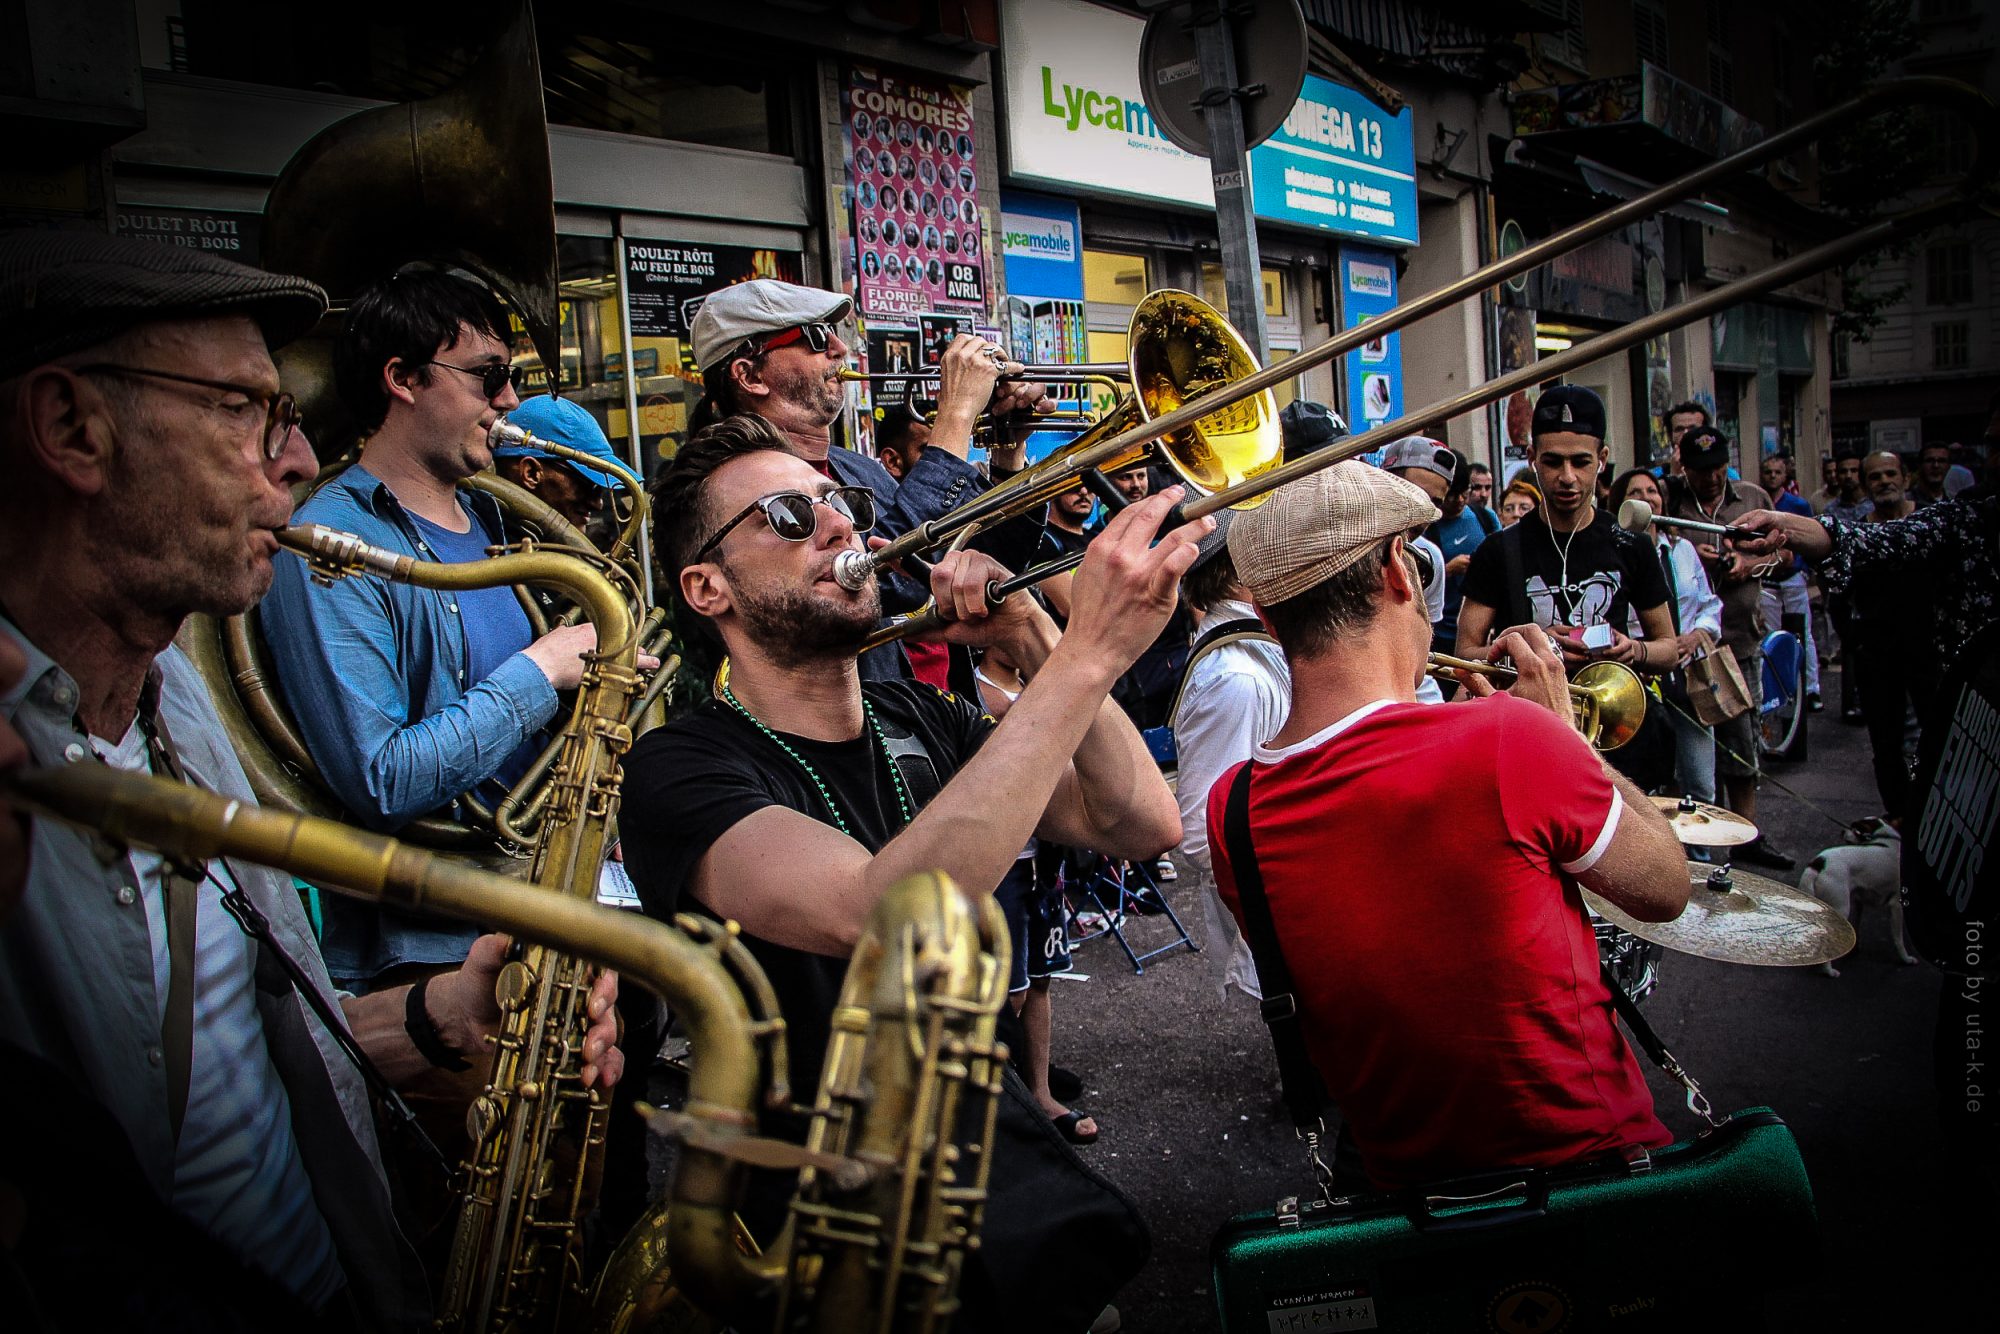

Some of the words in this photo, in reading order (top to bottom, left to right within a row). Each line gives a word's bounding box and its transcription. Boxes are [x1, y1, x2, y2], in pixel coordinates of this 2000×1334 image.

[851, 88, 971, 132] COMORES
[1282, 97, 1356, 152] OMEGA
[1358, 117, 1383, 160] 13
[117, 213, 184, 233] OULET
[189, 215, 239, 235] RÔTI
[202, 237, 241, 250] BOIS
[628, 245, 681, 262] POULET
[683, 248, 714, 265] RÔTI
[630, 260, 649, 271] AU
[650, 262, 672, 274] FEU
[673, 264, 689, 275] DE
[690, 265, 715, 277] BOIS
[952, 265, 974, 283] 08
[868, 288, 928, 304] FLORIDA
[948, 280, 982, 300] AVRIL
[869, 299, 929, 314] PALACE
[1917, 783, 1985, 914] BUTTS
[1320, 1287, 1356, 1301] WOMEN
[1607, 1296, 1656, 1319] Funky
